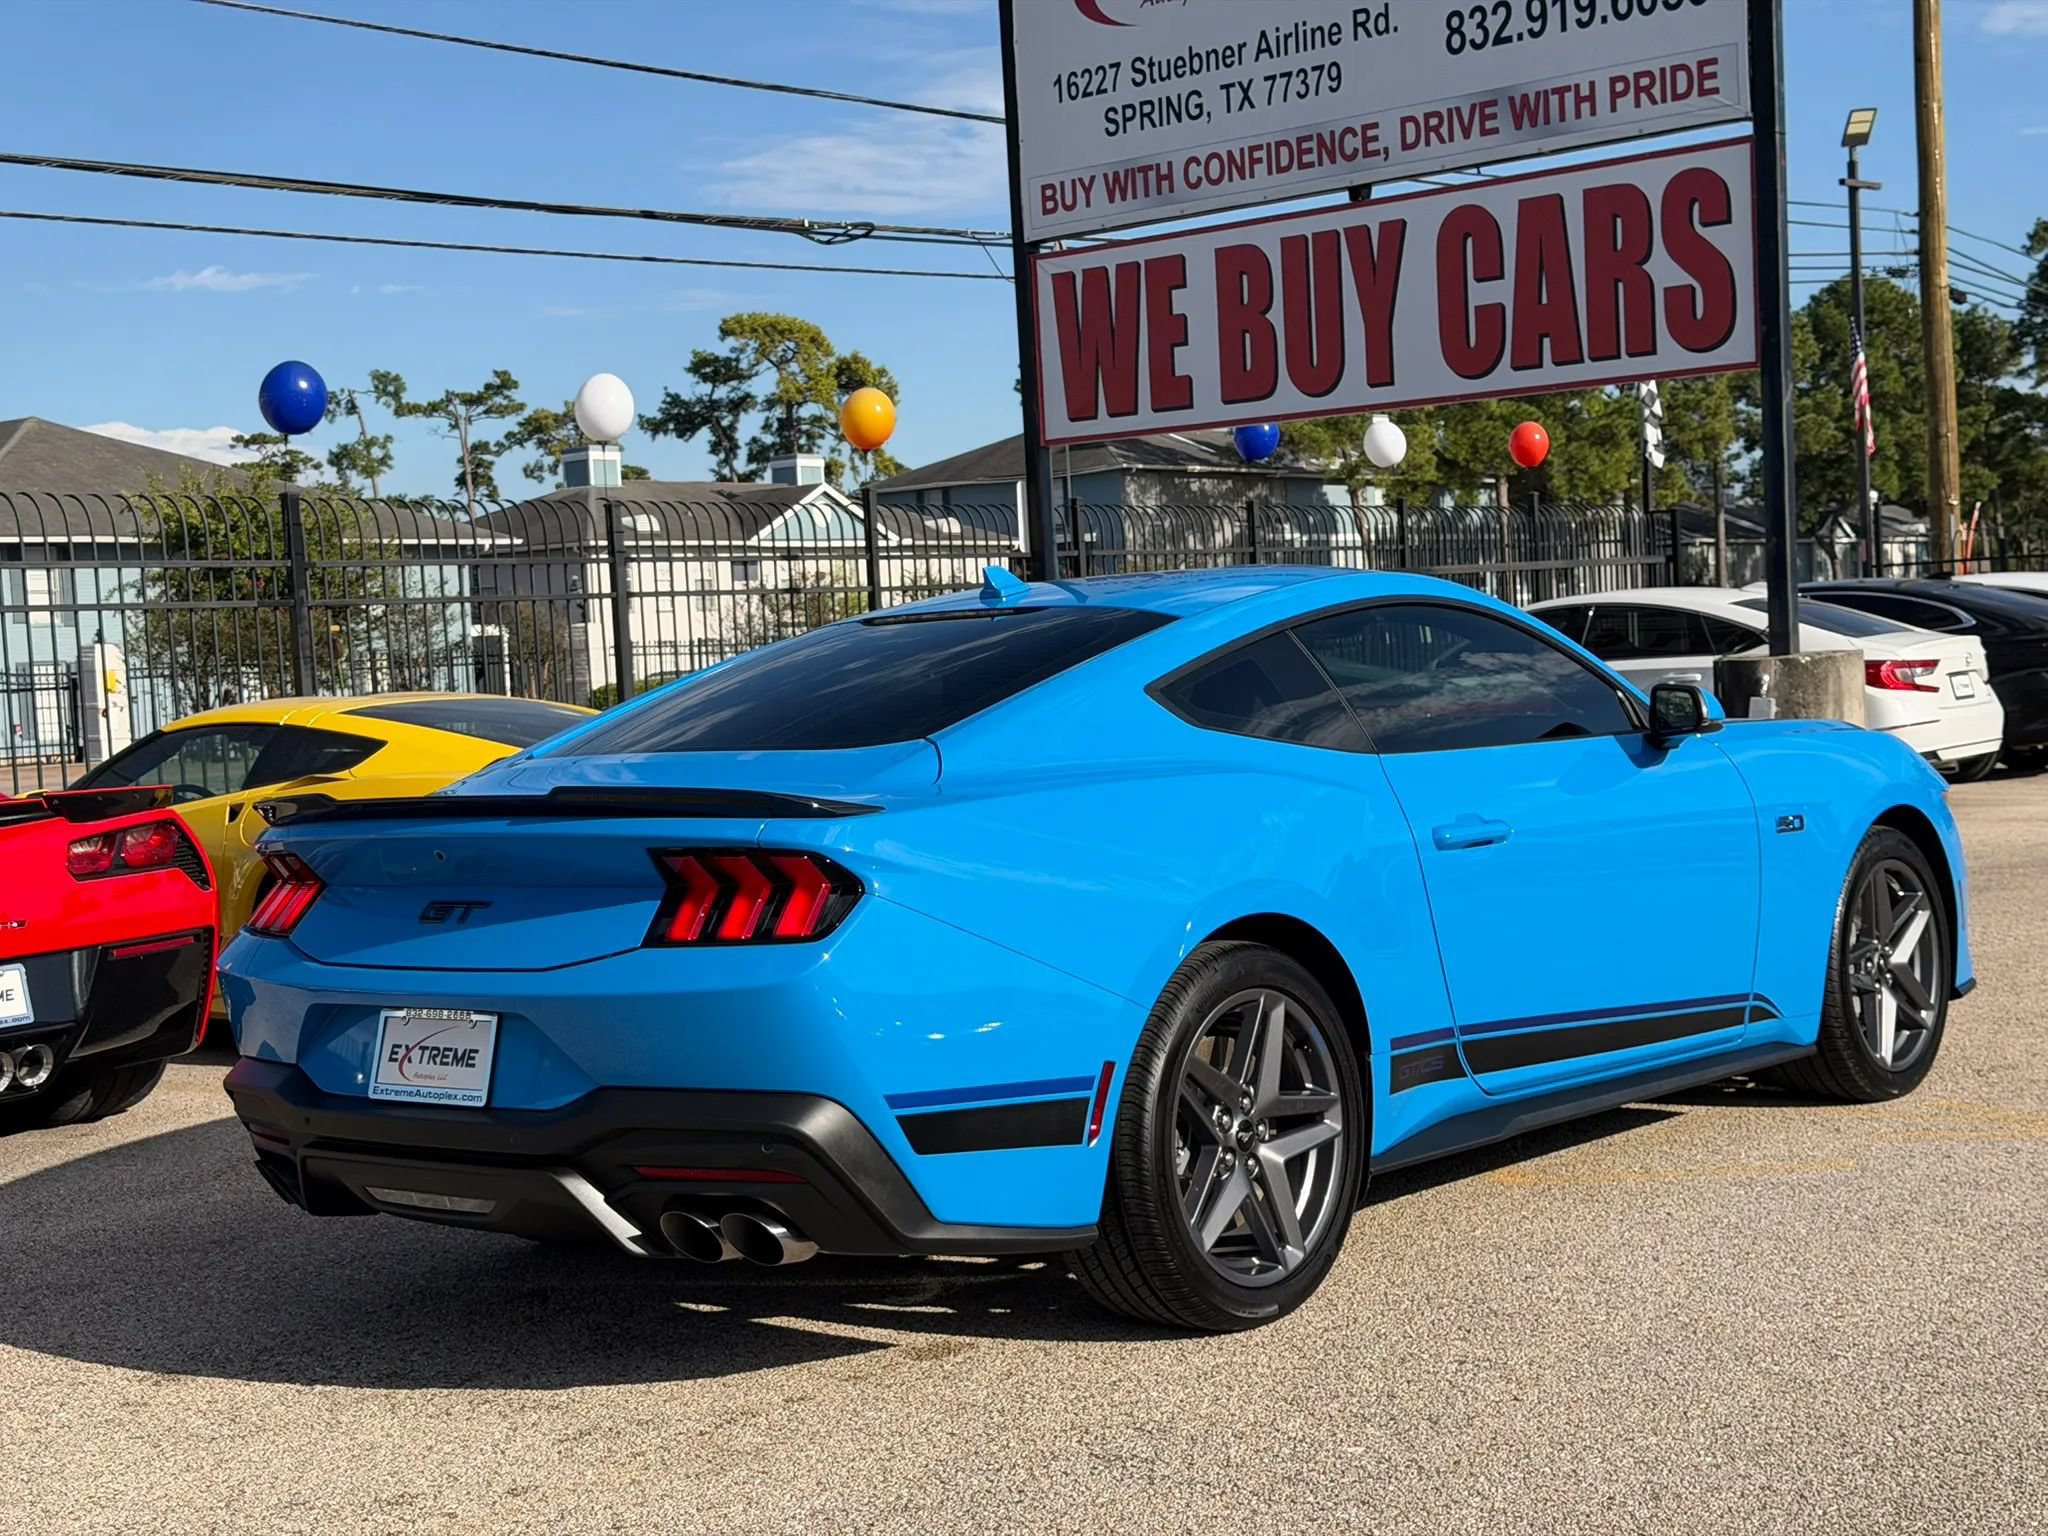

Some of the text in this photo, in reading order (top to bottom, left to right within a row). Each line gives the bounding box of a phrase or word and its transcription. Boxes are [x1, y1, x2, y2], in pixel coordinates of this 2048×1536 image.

[1053, 2, 1399, 104] 16227 Stuebner Airline Rd.
[1041, 57, 1720, 216] BUY WITH CONFIDENCE, DRIVE WITH PRIDE
[1104, 61, 1342, 137] SPRING, TX 77379
[1051, 167, 1737, 421] WE BUY CARS
[418, 900, 495, 924] GT
[388, 1043, 480, 1069] EXTREME
[372, 1086, 483, 1103] ExtremeAutoplex.com
